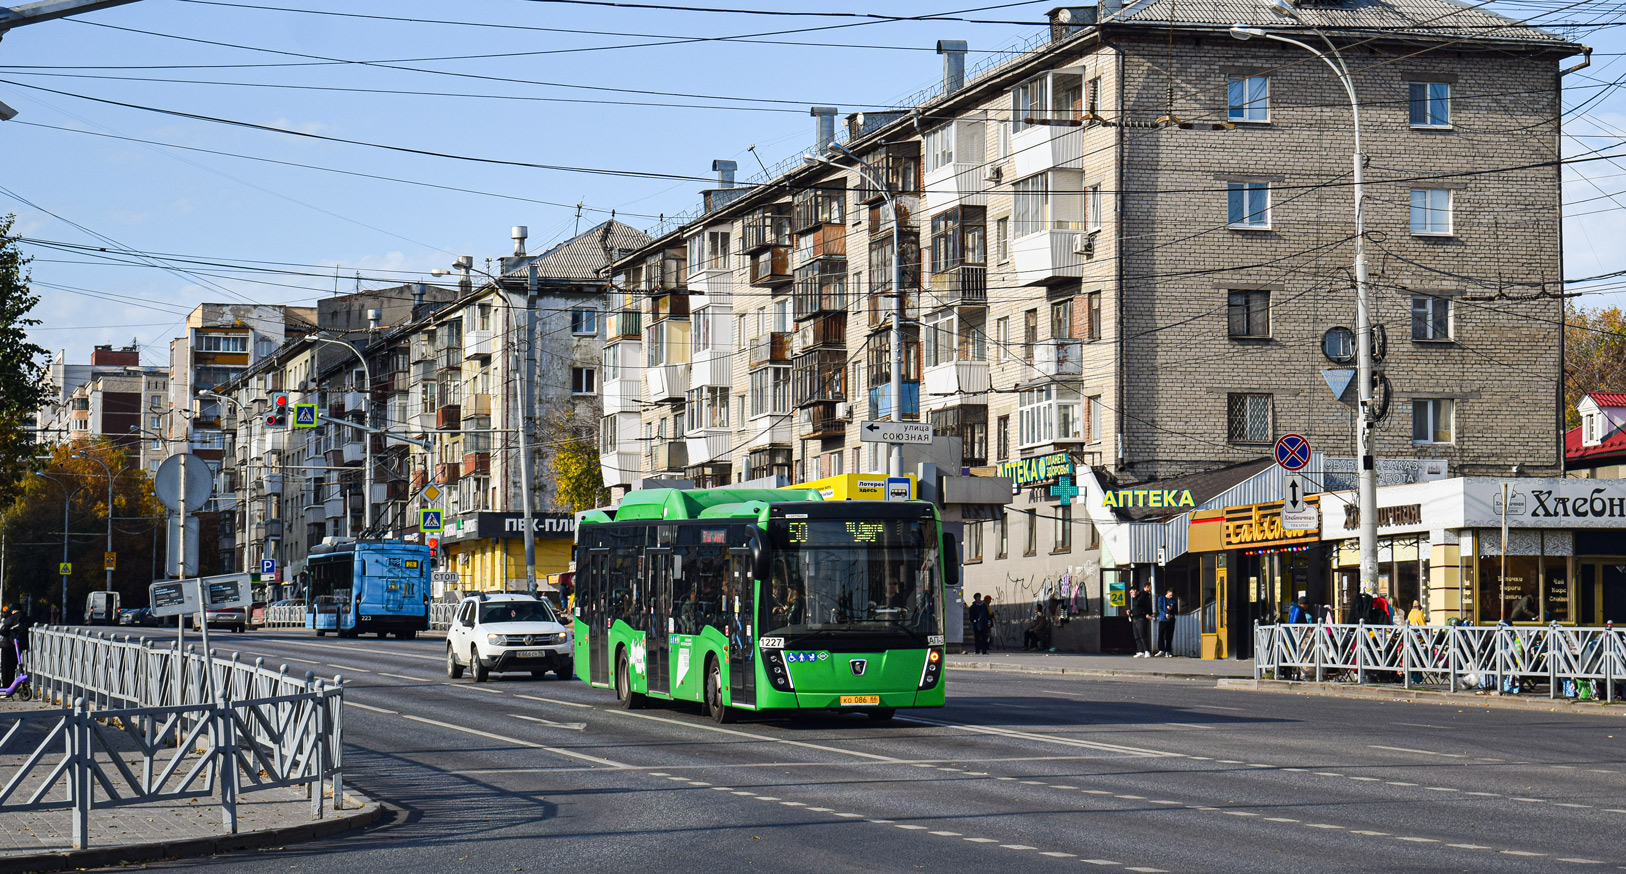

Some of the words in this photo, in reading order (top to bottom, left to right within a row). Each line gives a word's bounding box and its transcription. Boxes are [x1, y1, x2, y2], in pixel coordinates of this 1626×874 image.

[882, 432, 929, 441] СОЮЗНАЯ
[999, 458, 1038, 484] АПТЕКА
[1377, 473, 1415, 483] АБОТА
[1102, 489, 1196, 508] АПТЕКА
[789, 522, 808, 542] 50
[1111, 593, 1123, 602] 24
[761, 639, 783, 647] 1227
[854, 696, 868, 704] 086
